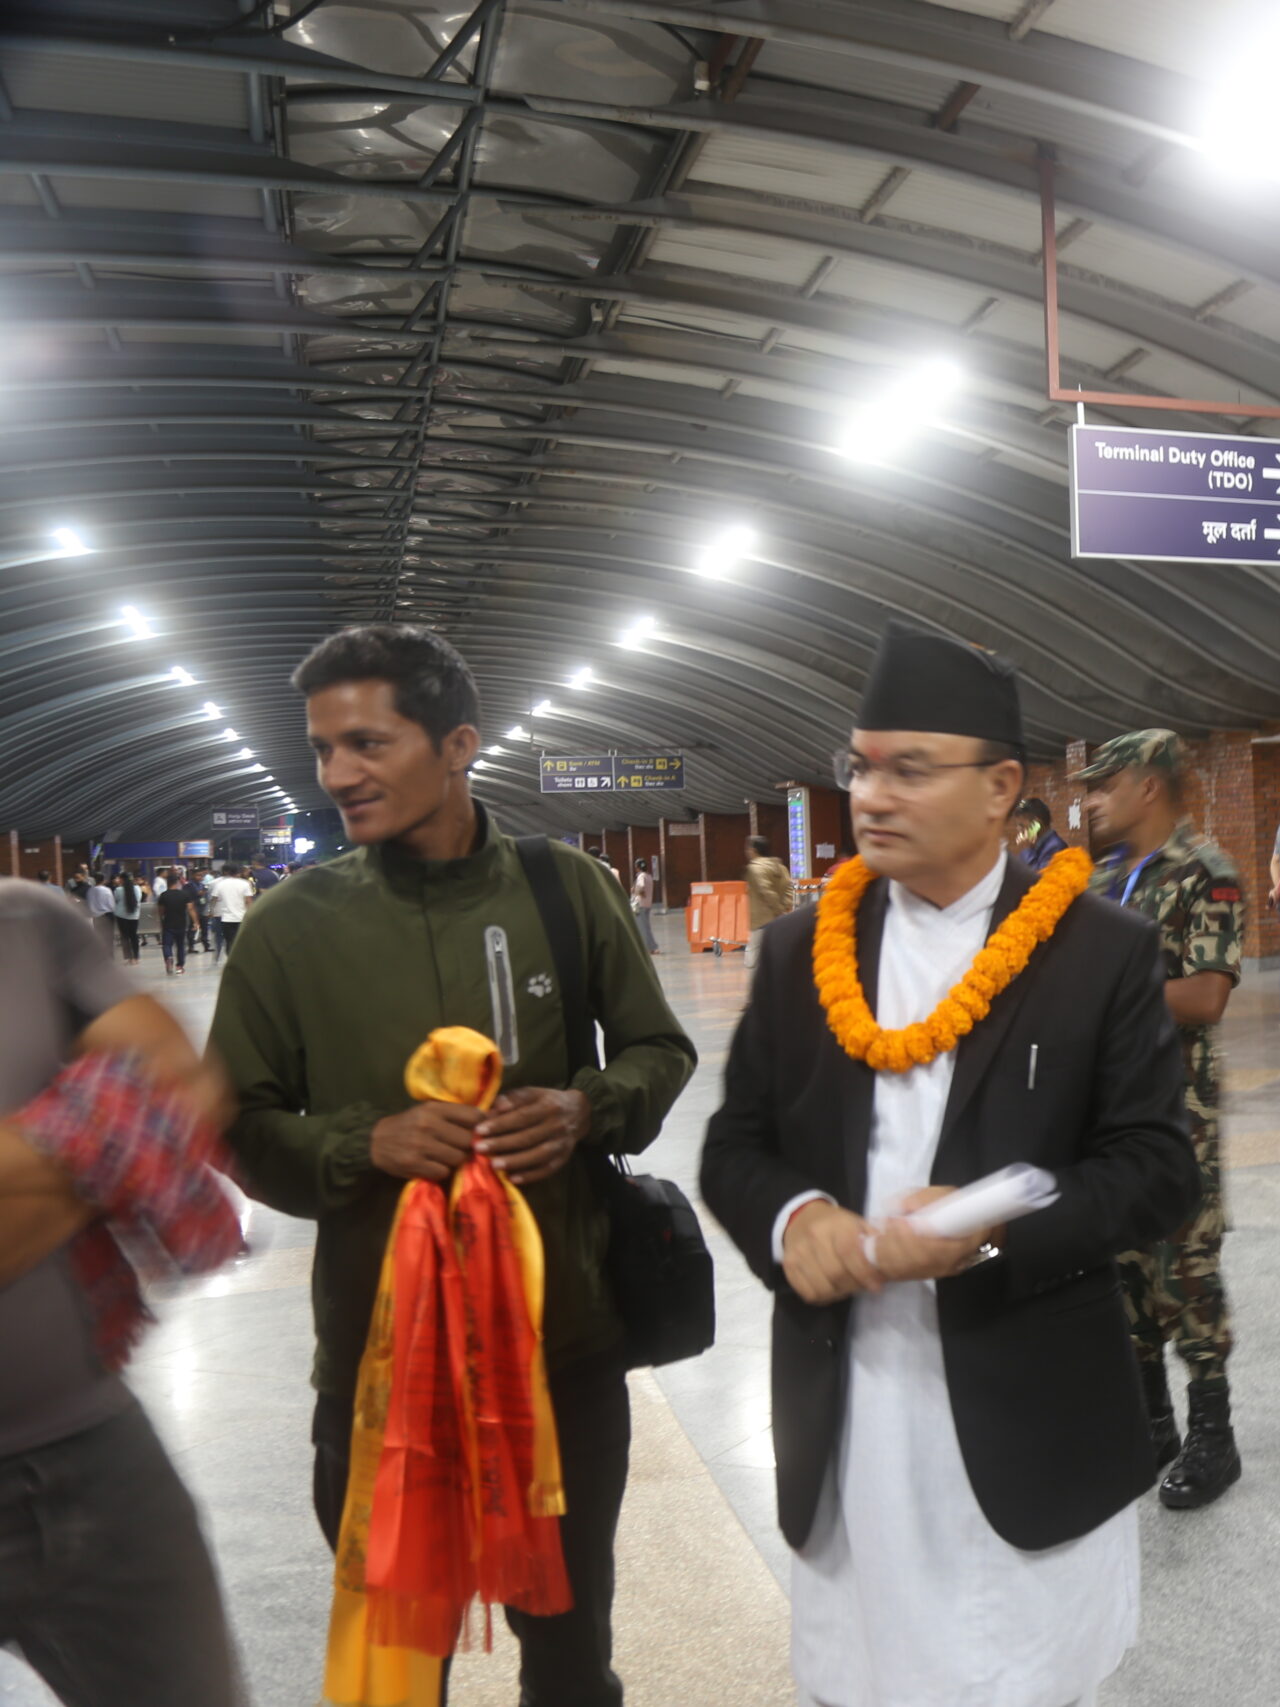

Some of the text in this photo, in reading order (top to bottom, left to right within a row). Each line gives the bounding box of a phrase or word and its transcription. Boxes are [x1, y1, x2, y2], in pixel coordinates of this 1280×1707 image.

[1095, 441, 1256, 469] Terminal Duty Office
[1208, 470, 1253, 492] (TDO)
[1202, 518, 1257, 544] मूल दर्ता
